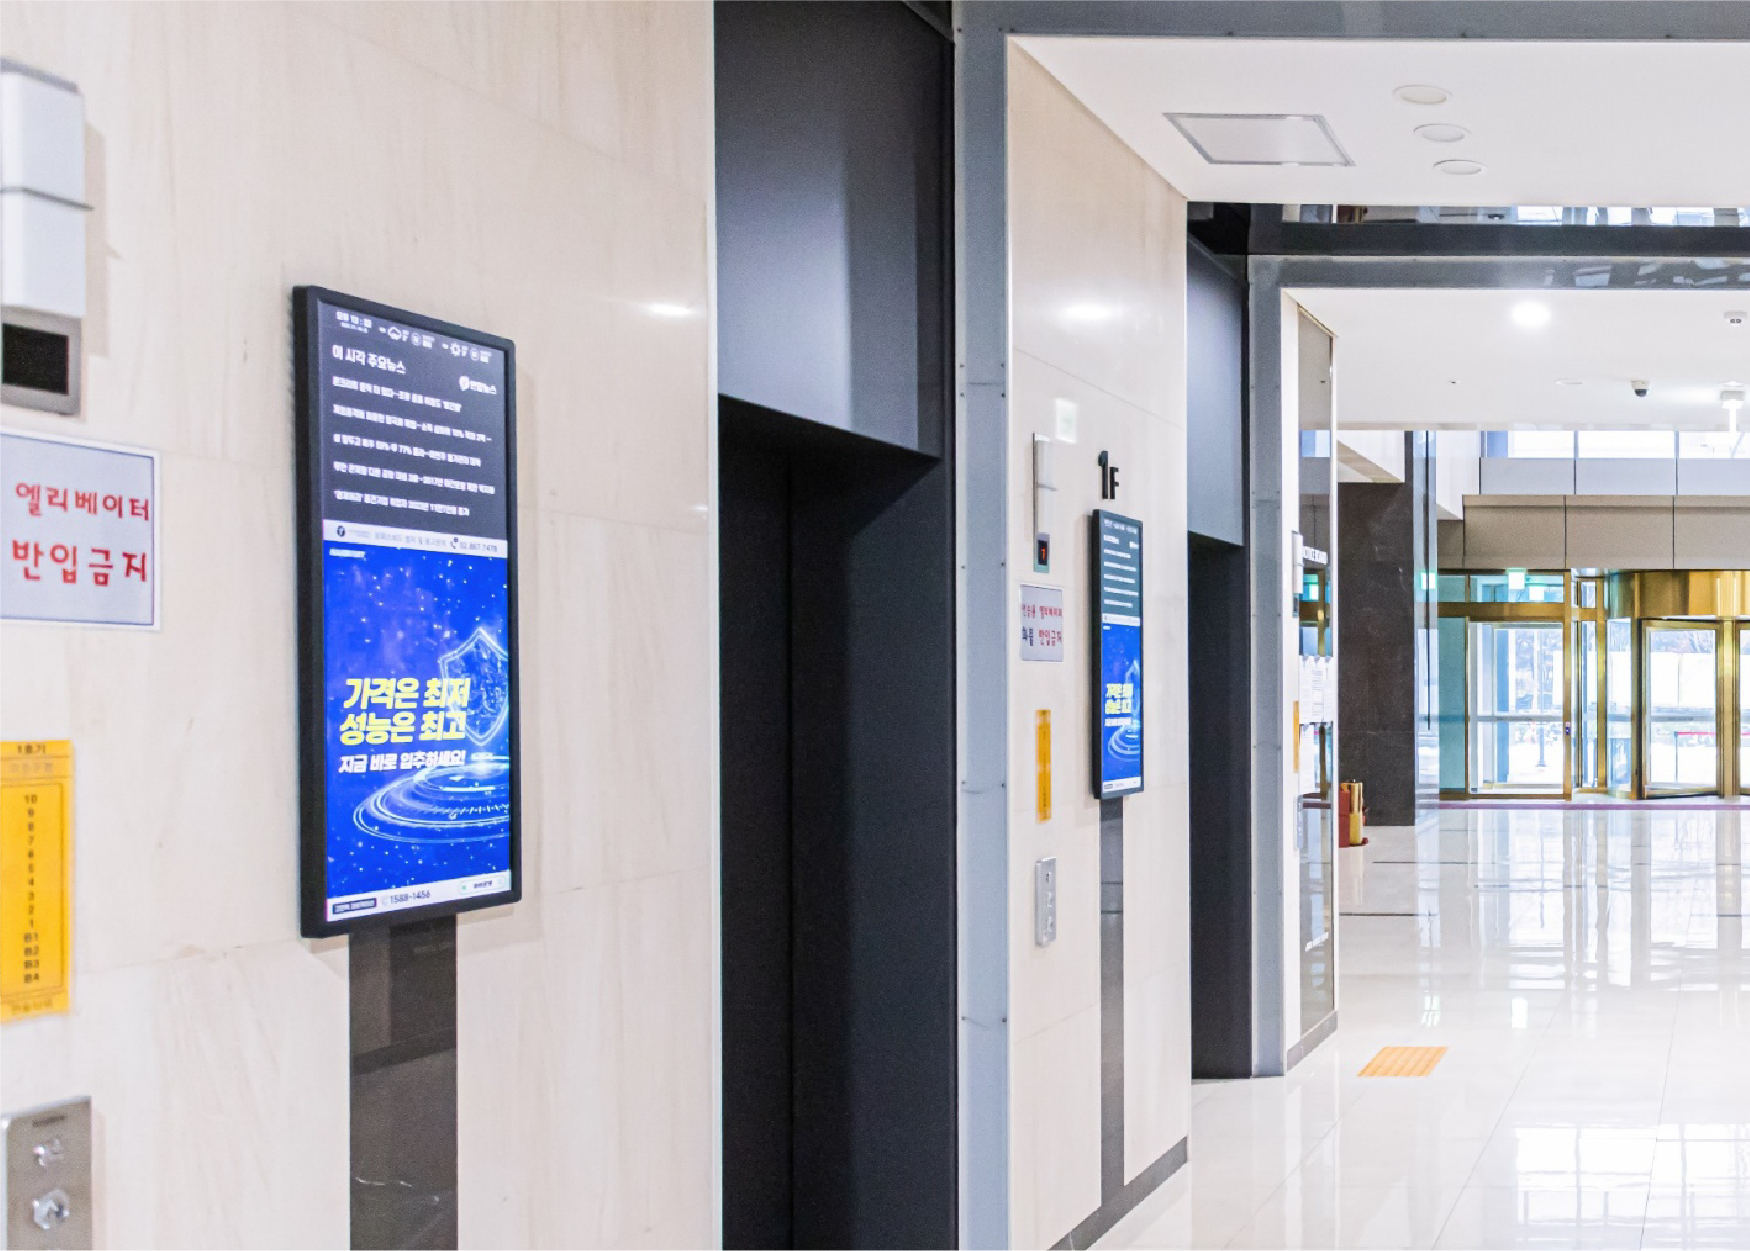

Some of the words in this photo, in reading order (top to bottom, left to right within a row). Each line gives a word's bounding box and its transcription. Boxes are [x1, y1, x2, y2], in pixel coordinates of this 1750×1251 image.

[345, 348, 366, 366] 시각
[368, 353, 407, 375] 주요뉴스
[1098, 450, 1119, 499] 1F
[15, 483, 149, 521] 엘리베이터
[12, 539, 148, 587] 반입금지
[343, 677, 420, 710] 가격은
[423, 677, 471, 709] 최저
[339, 711, 416, 746] 성능은
[418, 710, 467, 742] 최고
[338, 753, 368, 774] 지금
[369, 752, 398, 773] 바로
